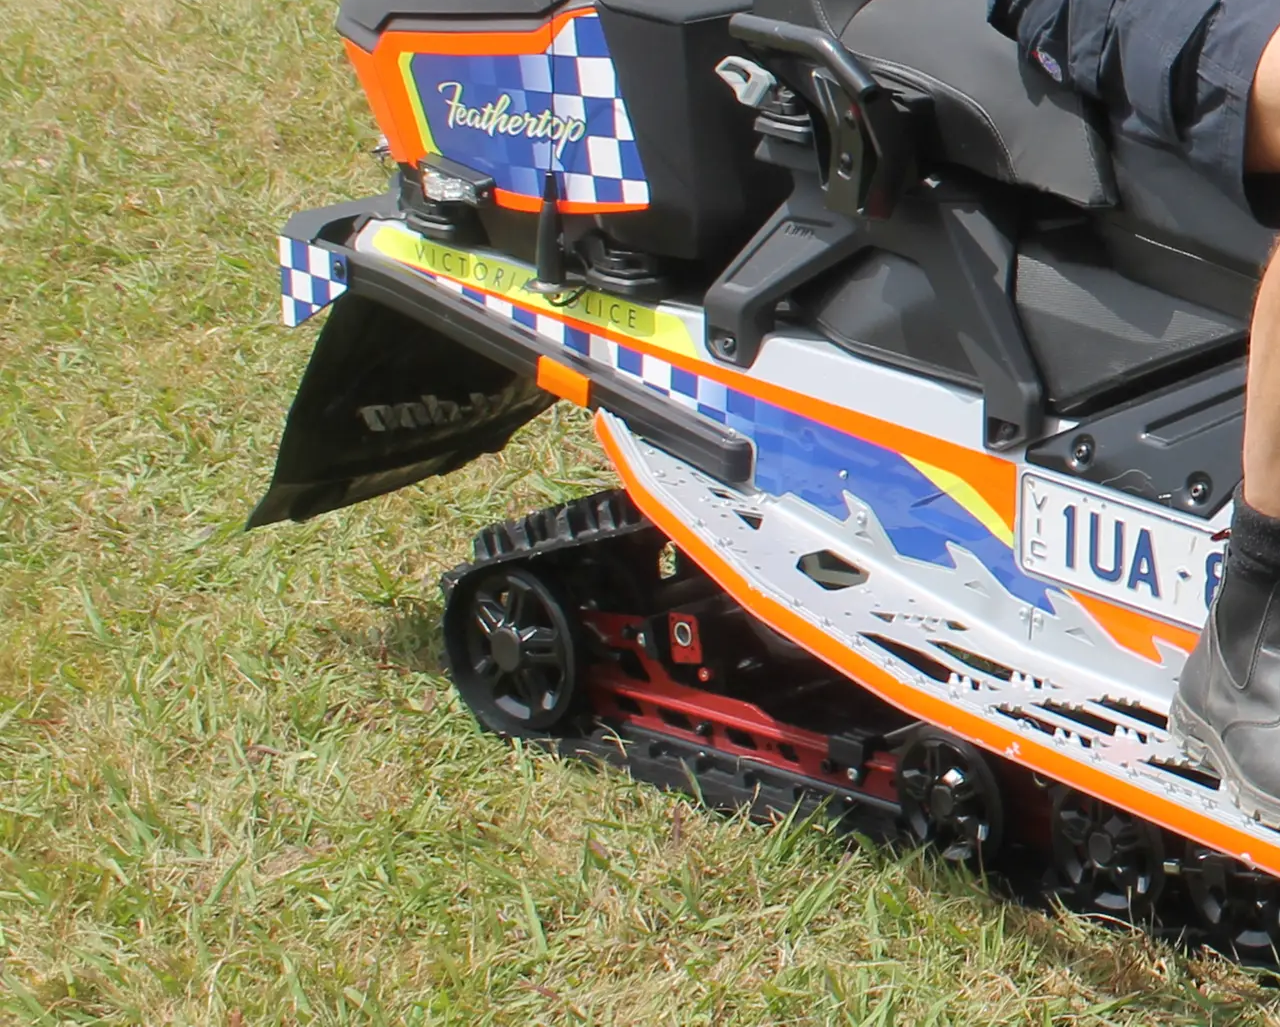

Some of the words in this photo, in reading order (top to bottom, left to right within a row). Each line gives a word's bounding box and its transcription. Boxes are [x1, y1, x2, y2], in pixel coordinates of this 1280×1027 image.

[437, 81, 586, 160] Feathertop
[566, 289, 637, 329] OLICE
[1031, 493, 1048, 560] VIC
